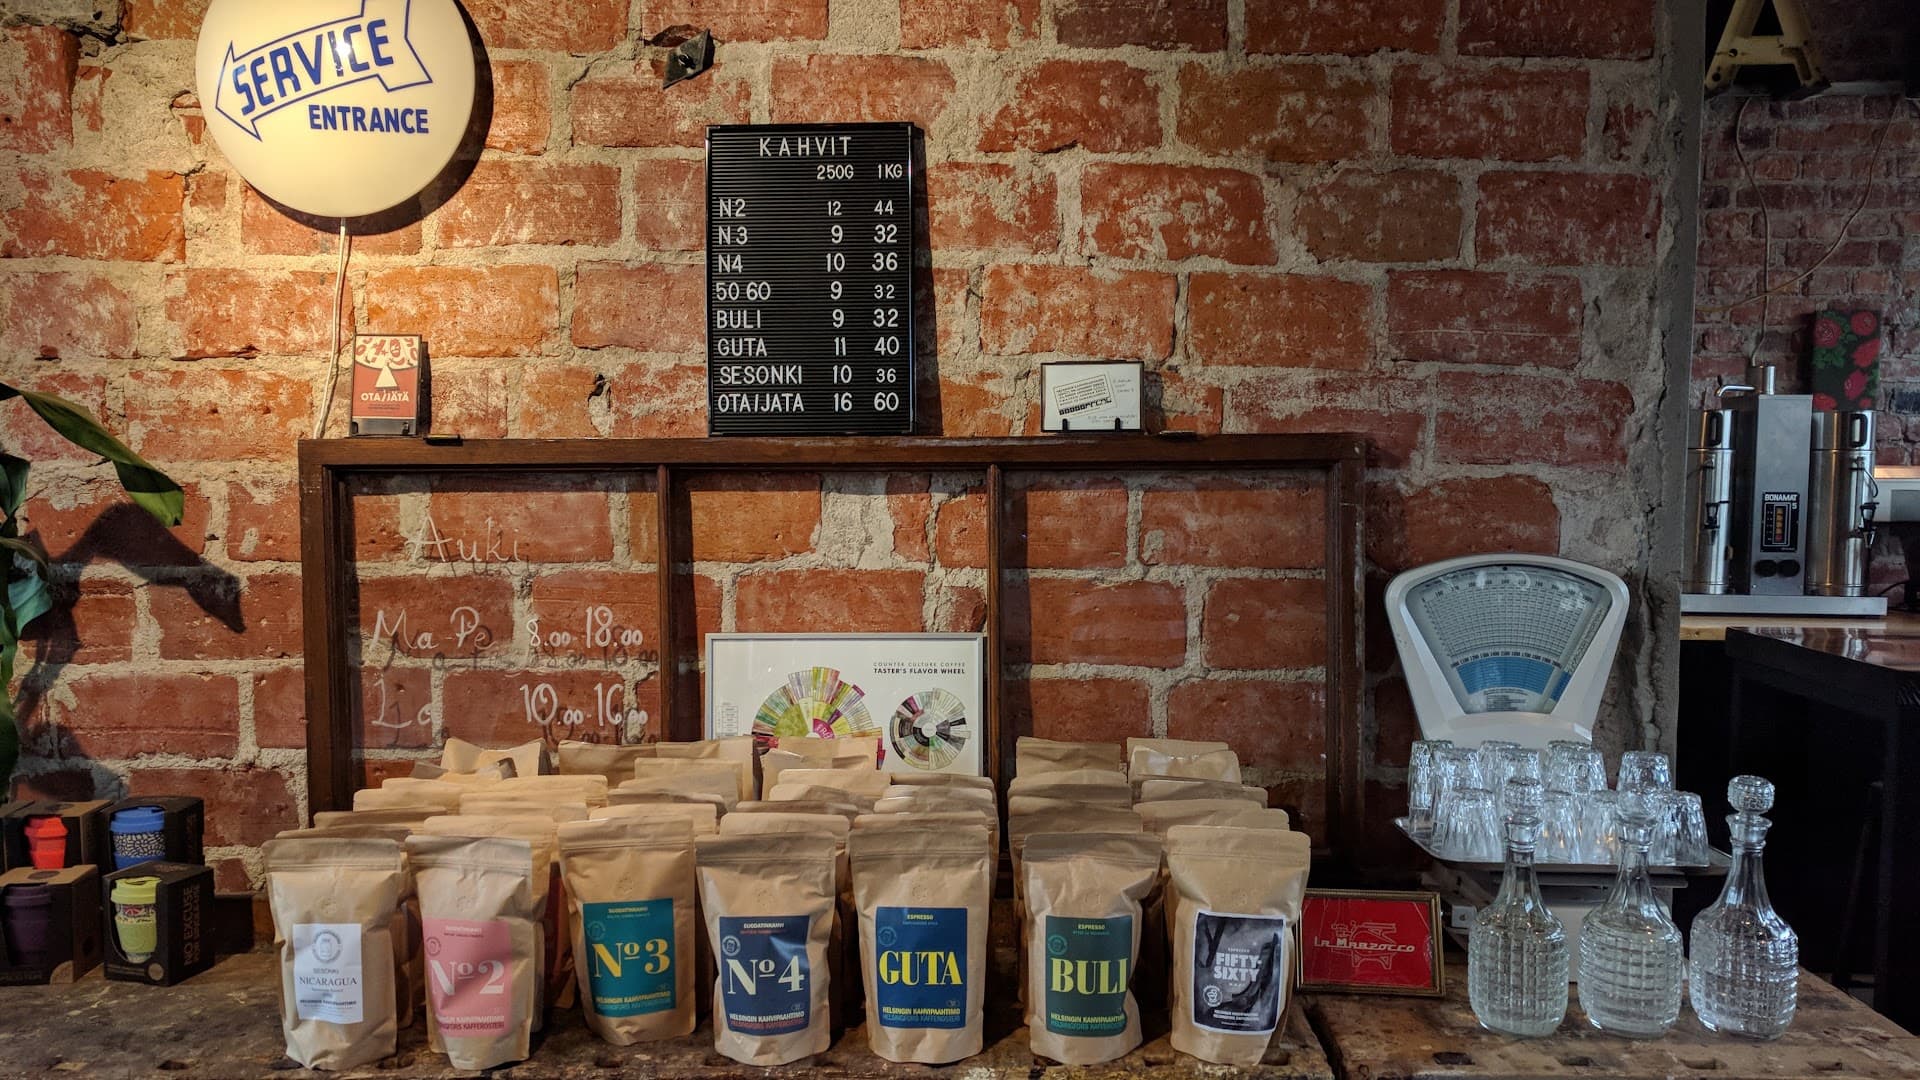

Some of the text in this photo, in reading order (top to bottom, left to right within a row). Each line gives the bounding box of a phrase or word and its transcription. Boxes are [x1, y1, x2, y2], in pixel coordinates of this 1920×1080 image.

[232, 19, 394, 116] SERVICE
[308, 104, 429, 134] ENTRANCE
[759, 136, 851, 157] KAHVIT
[816, 164, 854, 180] 250G
[719, 198, 894, 217] N2 12 44
[718, 224, 898, 245] N3 9 32
[718, 252, 898, 273] N4 10 36
[830, 280, 843, 300] 9
[873, 284, 895, 299] 32
[716, 308, 899, 329] BULI 9 32
[717, 336, 900, 357] GUTA 11 40
[719, 364, 896, 385] SESONKI 10 36
[833, 392, 853, 412] 16
[874, 391, 900, 411] 60
[404, 514, 522, 562] Auki
[878, 950, 963, 986] GUTA
[1050, 957, 1128, 995] BULI
[1213, 966, 1260, 982] SIXTY
[299, 975, 358, 987] NICARAGUA
